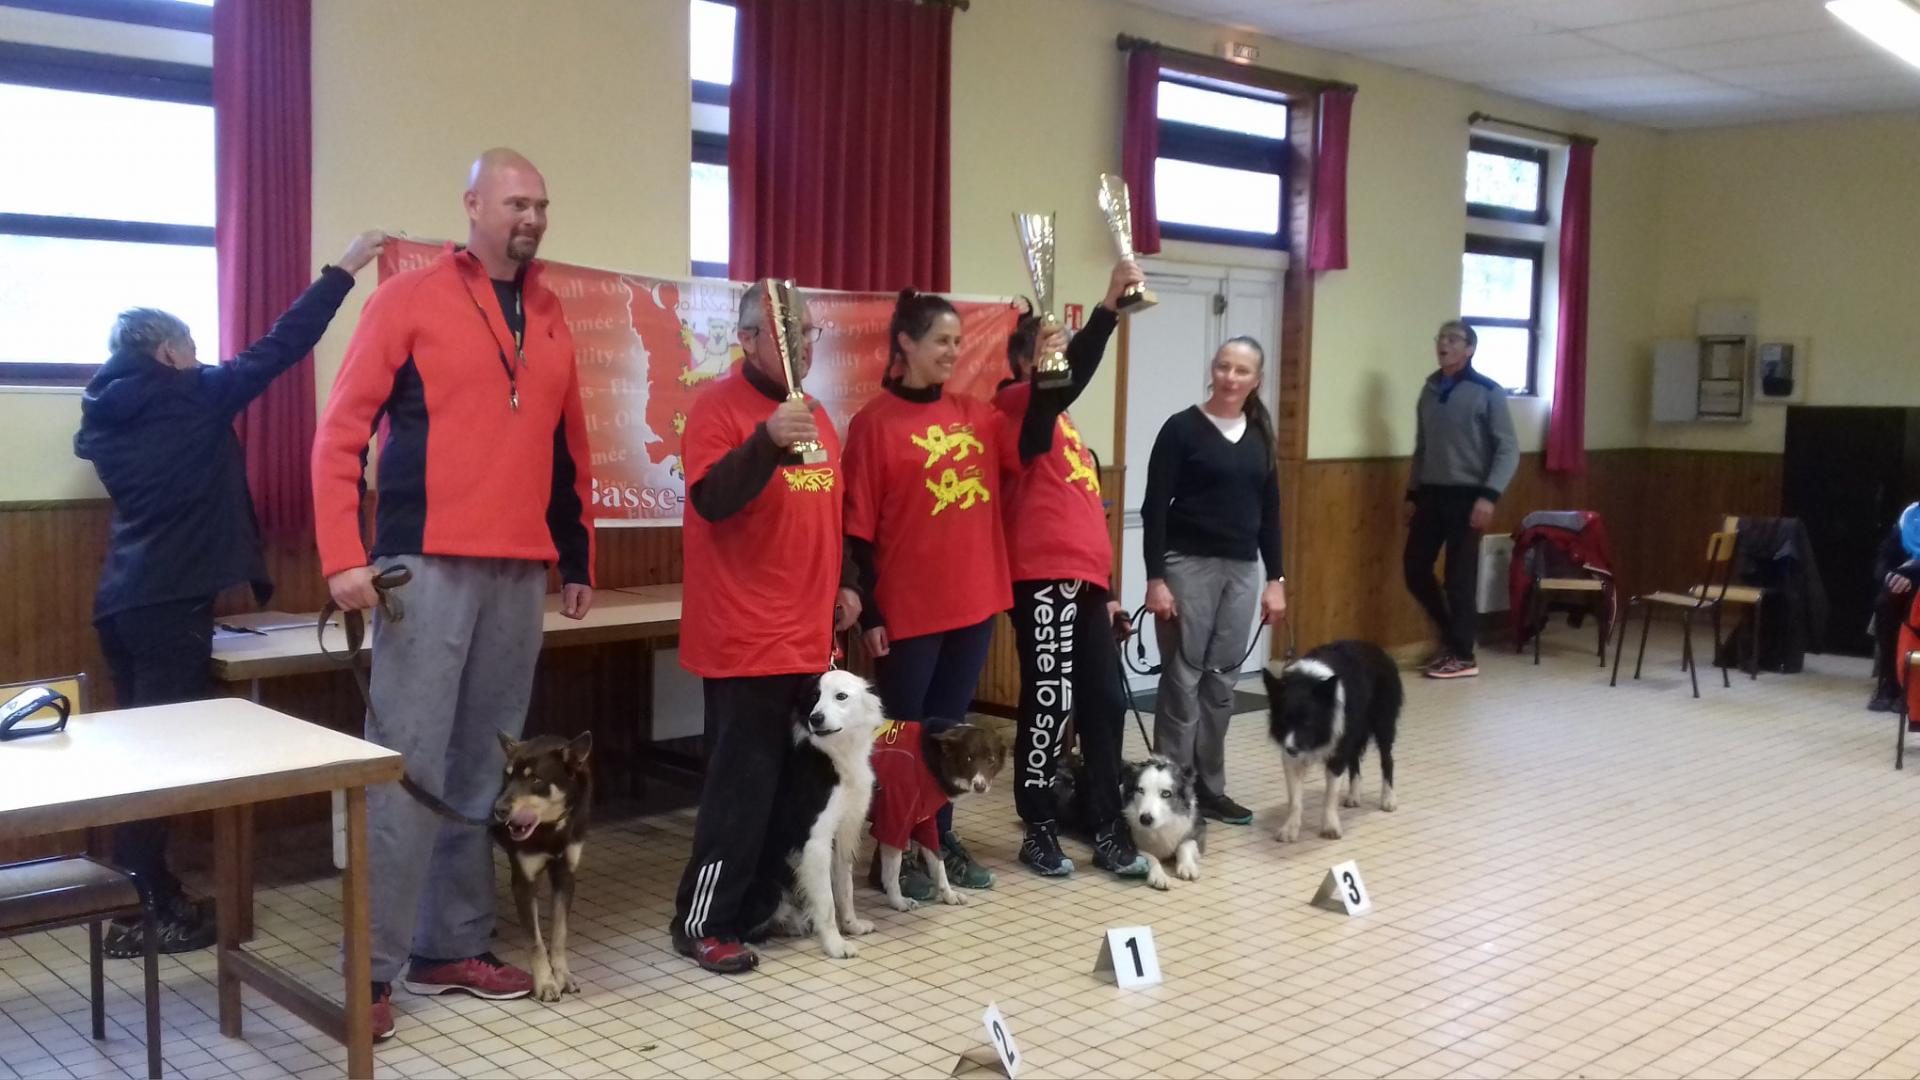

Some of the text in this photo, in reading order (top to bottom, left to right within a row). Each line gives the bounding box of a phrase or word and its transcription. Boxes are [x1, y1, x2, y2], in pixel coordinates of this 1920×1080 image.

[1025, 584, 1060, 788] veste lo sport
[1343, 871, 1361, 905] 3
[1125, 937, 1145, 978] 1
[993, 1020, 1015, 1066] 2
